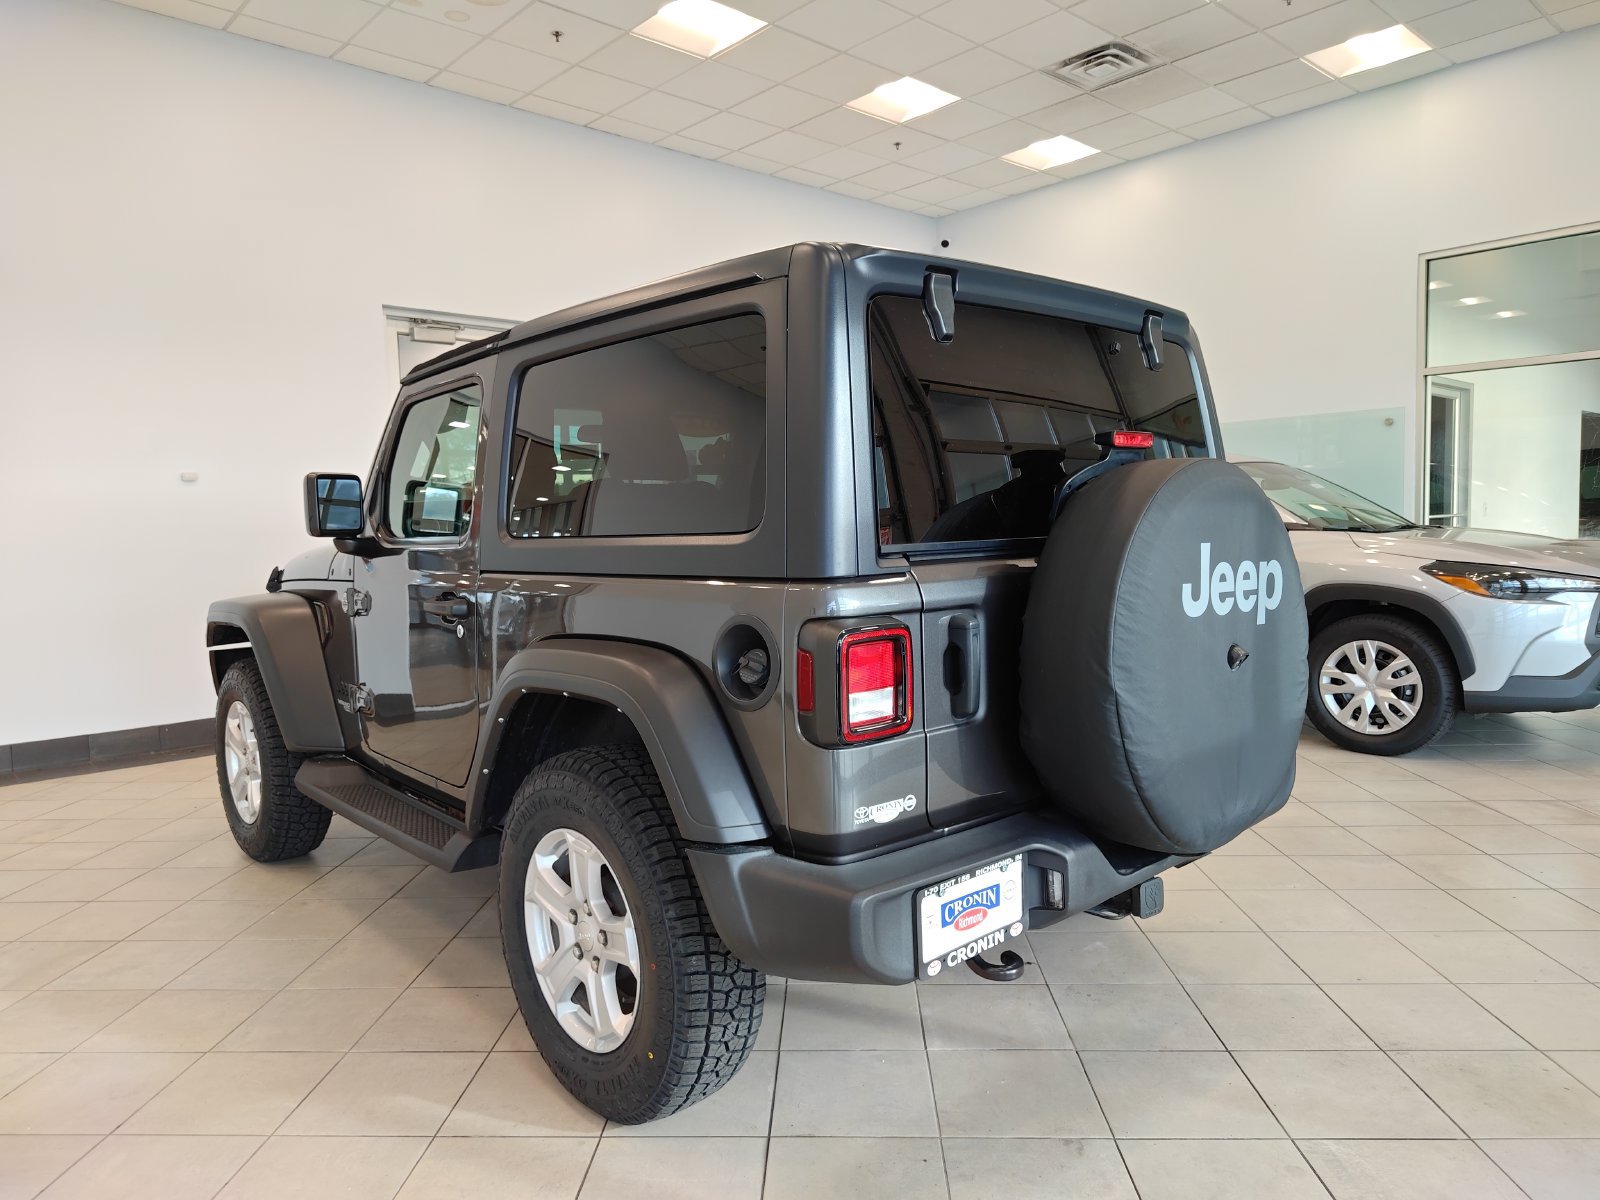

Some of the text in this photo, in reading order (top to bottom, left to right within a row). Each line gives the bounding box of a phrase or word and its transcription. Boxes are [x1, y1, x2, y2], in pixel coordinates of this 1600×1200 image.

[1182, 543, 1283, 625] Jeep
[924, 886, 939, 897] I-70
[940, 878, 956, 891] EXIT
[1014, 853, 1023, 862] IN
[944, 886, 998, 924] CRONIN
[958, 909, 984, 929] Richmond
[947, 929, 1005, 967] CRONIN
